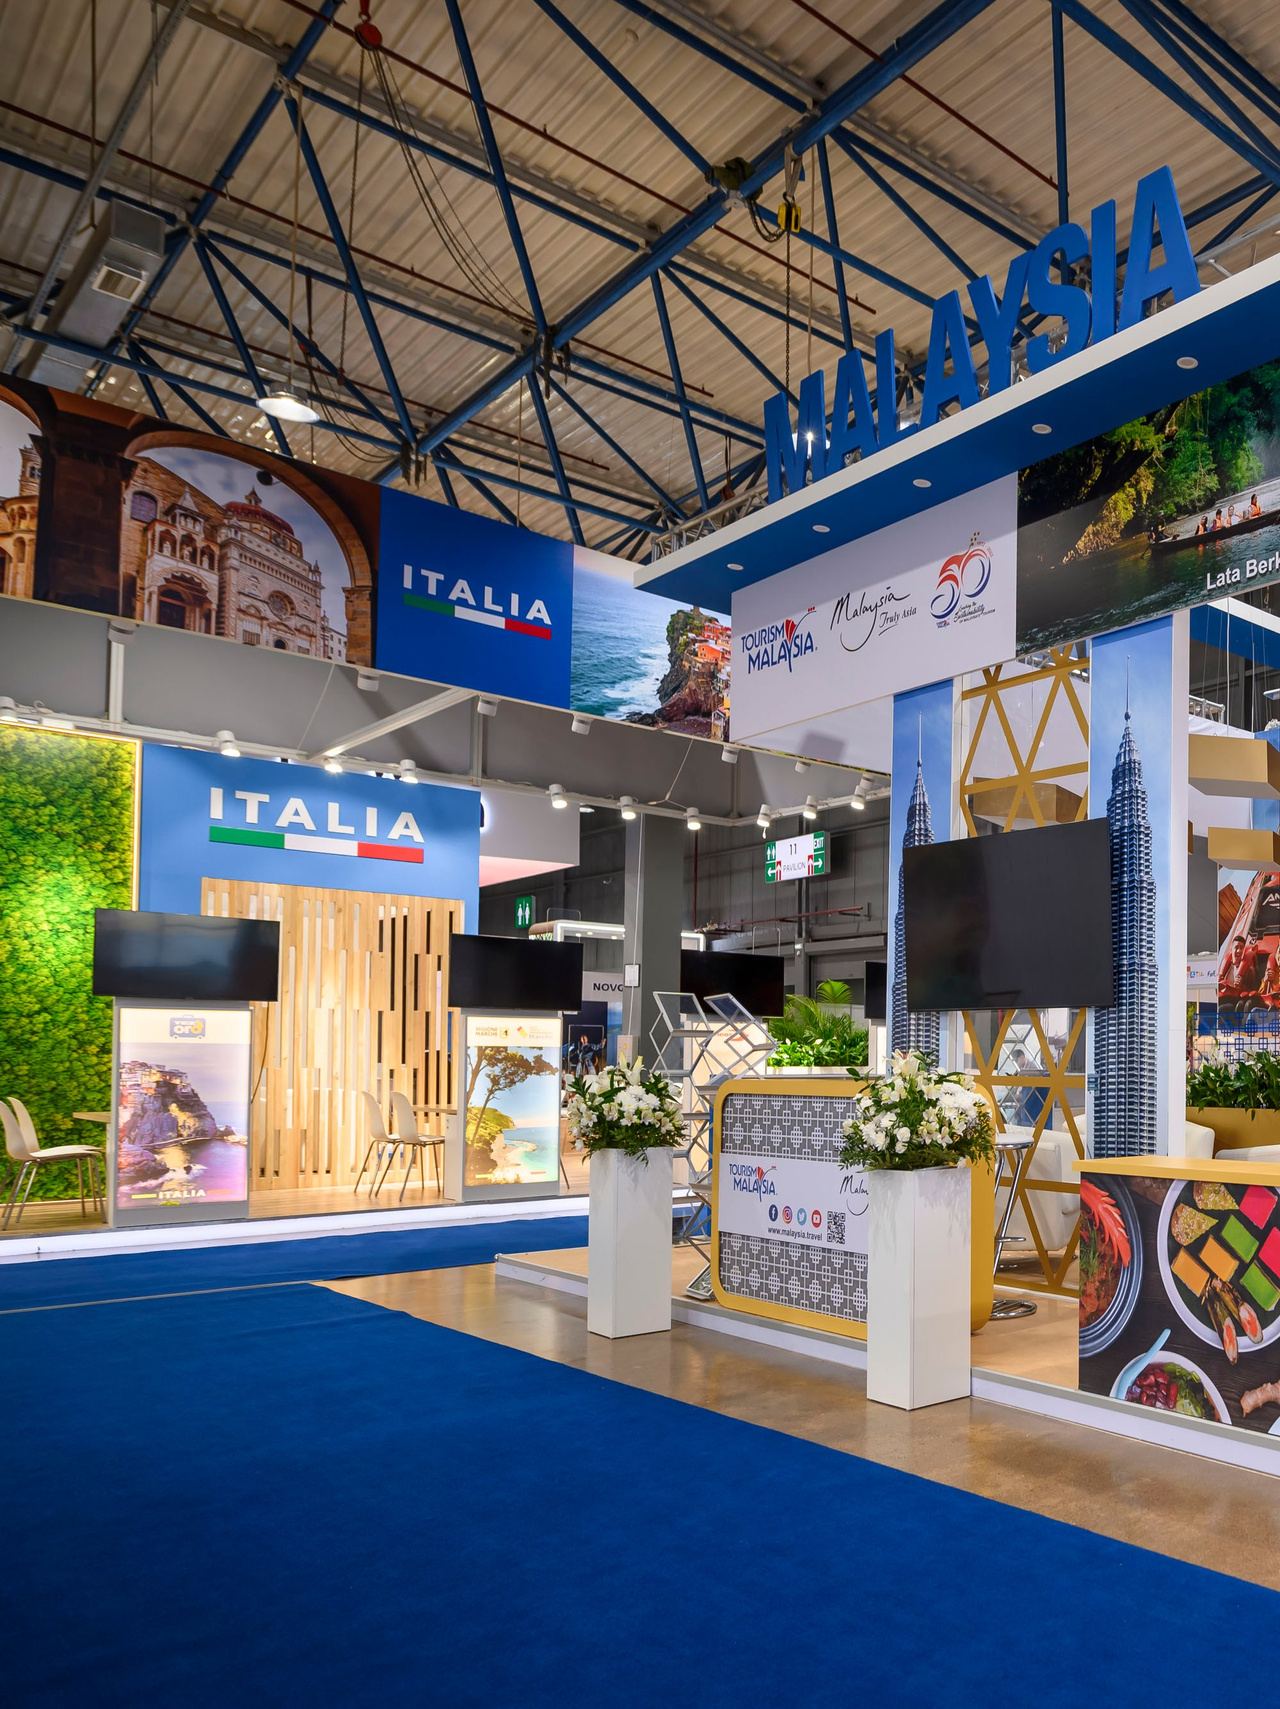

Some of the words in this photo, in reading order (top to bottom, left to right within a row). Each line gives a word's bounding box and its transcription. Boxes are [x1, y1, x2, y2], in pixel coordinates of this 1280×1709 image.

[764, 165, 1200, 504] MALAYSIA
[1206, 569, 1240, 590] Lata
[403, 564, 552, 625] ITALIA
[830, 586, 911, 653] Malaysia
[879, 612, 900, 629] Truly
[901, 606, 917, 620] Asia
[741, 622, 785, 653] TOURISM
[748, 631, 815, 674] MALAYSIA
[210, 787, 425, 843] ITALIA
[789, 843, 797, 855] 11
[814, 837, 824, 849] EXIT
[783, 861, 806, 872] PAVILION
[729, 1163, 758, 1178] TOURISM
[158, 1189, 206, 1199] ITALIA
[733, 1177, 776, 1203] MALAYSIA
[767, 1227, 822, 1241] www.malaysia.travel
